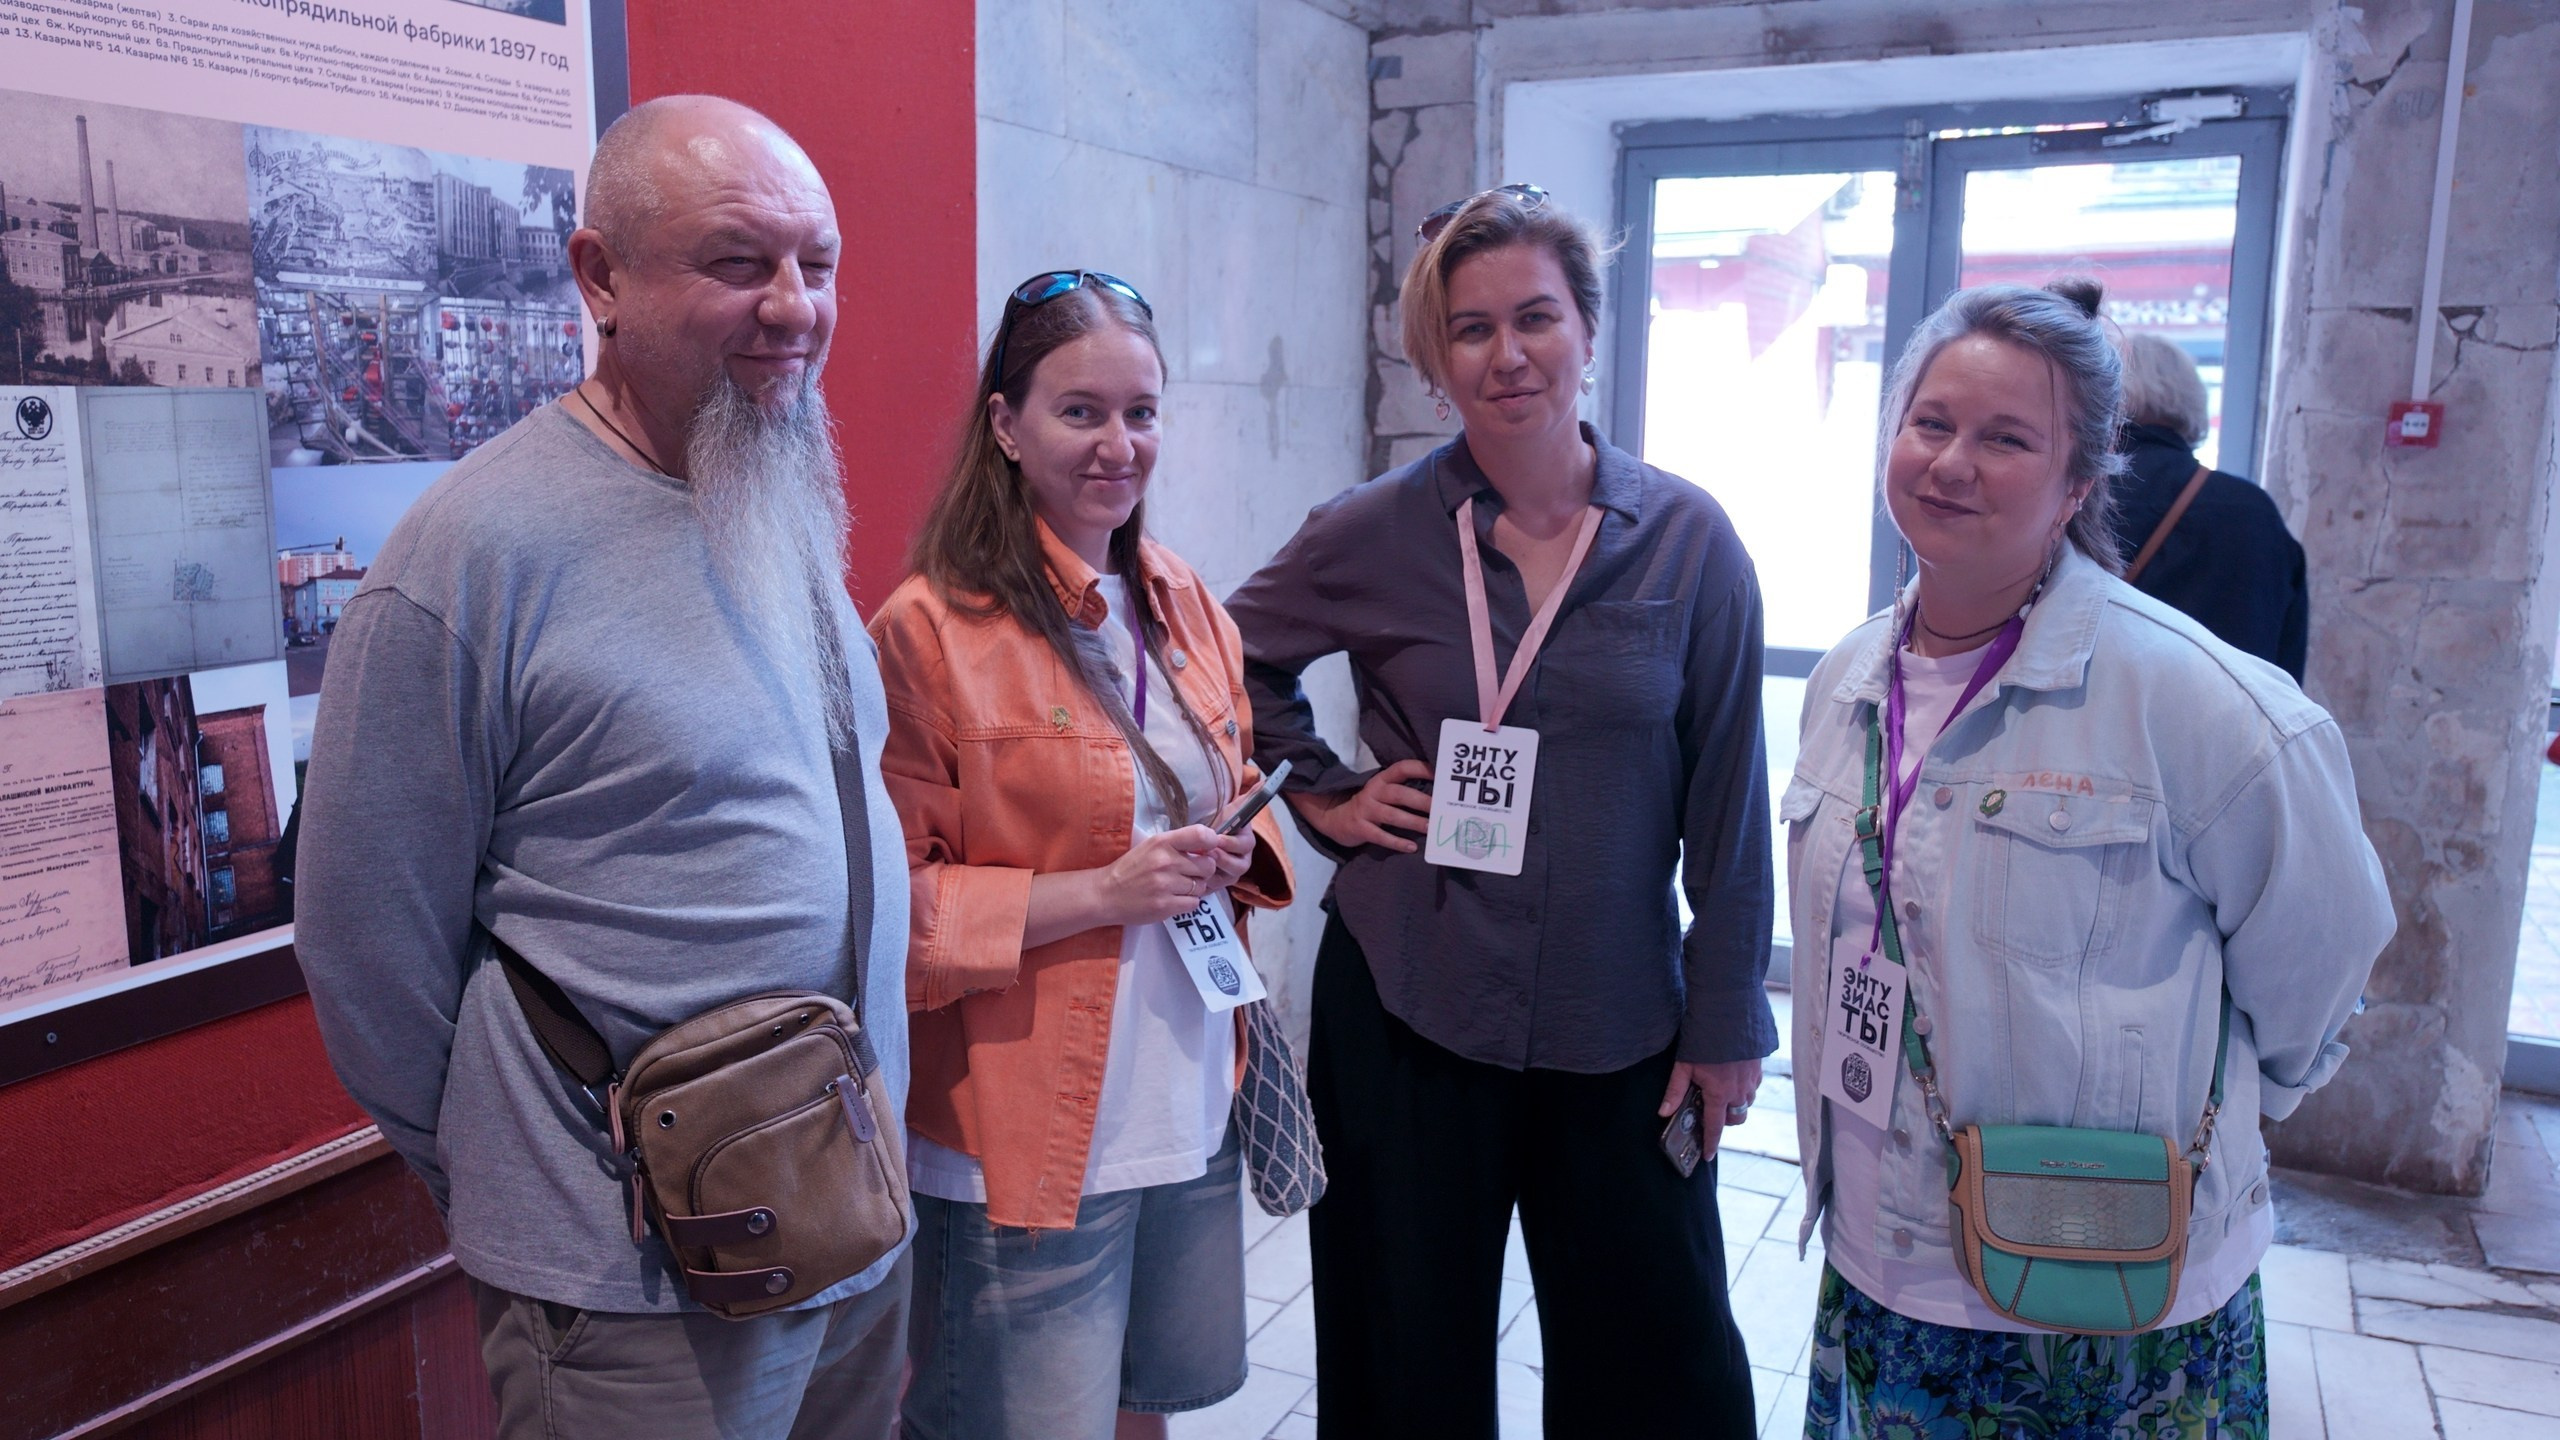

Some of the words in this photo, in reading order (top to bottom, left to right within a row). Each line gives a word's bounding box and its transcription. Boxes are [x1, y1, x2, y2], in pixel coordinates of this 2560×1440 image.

[0, 0, 90, 20] оизводственный
[92, 15, 128, 28] корпус
[149, 22, 260, 50] Прядильно-крутильный
[261, 46, 276, 56] цех
[397, 71, 411, 80] цех
[117, 3, 161, 21] (желтая)
[168, 13, 178, 23] 3.
[180, 15, 209, 29] Сараи
[211, 23, 229, 33] для
[231, 26, 297, 45] хозяйственных
[299, 40, 321, 51] нужд
[360, 52, 389, 64] каждое
[431, 64, 441, 73] на
[403, 19, 486, 53] фабрики
[490, 37, 536, 62] 1897
[540, 51, 569, 72] год
[15, 27, 32, 38] 13.
[35, 31, 81, 48] Казарма
[84, 39, 103, 51] №5
[107, 43, 124, 54] 14.
[125, 46, 169, 62] Казарма
[170, 54, 189, 66] №6
[193, 58, 208, 69] 15.
[209, 61, 248, 76] Казарма
[261, 73, 291, 85] корпус
[292, 76, 329, 90] фабрики
[330, 82, 376, 98] Трубецкого
[392, 92, 425, 106] Казарма
[21, 15, 40, 25] цех
[46, 18, 65, 30] 6ж.
[68, 22, 131, 42] Крутильный
[134, 35, 151, 45] цех
[156, 38, 170, 49] 6з.
[173, 41, 232, 59] Прядильный
[234, 53, 239, 61] и
[241, 55, 292, 70] трепальные
[294, 64, 314, 75] цеха
[326, 68, 358, 81] Склады
[370, 77, 404, 91] Казарма
[455, 92, 485, 105] Казарма
[1452, 759, 1516, 780] ЗИАС
[1454, 743, 1518, 764] ЭНТУ
[1451, 775, 1514, 808] ТЫ
[2021, 772, 2095, 797] ЛЕНА
[1436, 815, 1513, 858] ИРА
[1175, 914, 1225, 946] ТЫ
[1842, 983, 1890, 1020] ЗИАС
[1843, 966, 1892, 1001] ЭНТУ
[1840, 1001, 1888, 1052] ТЫ
